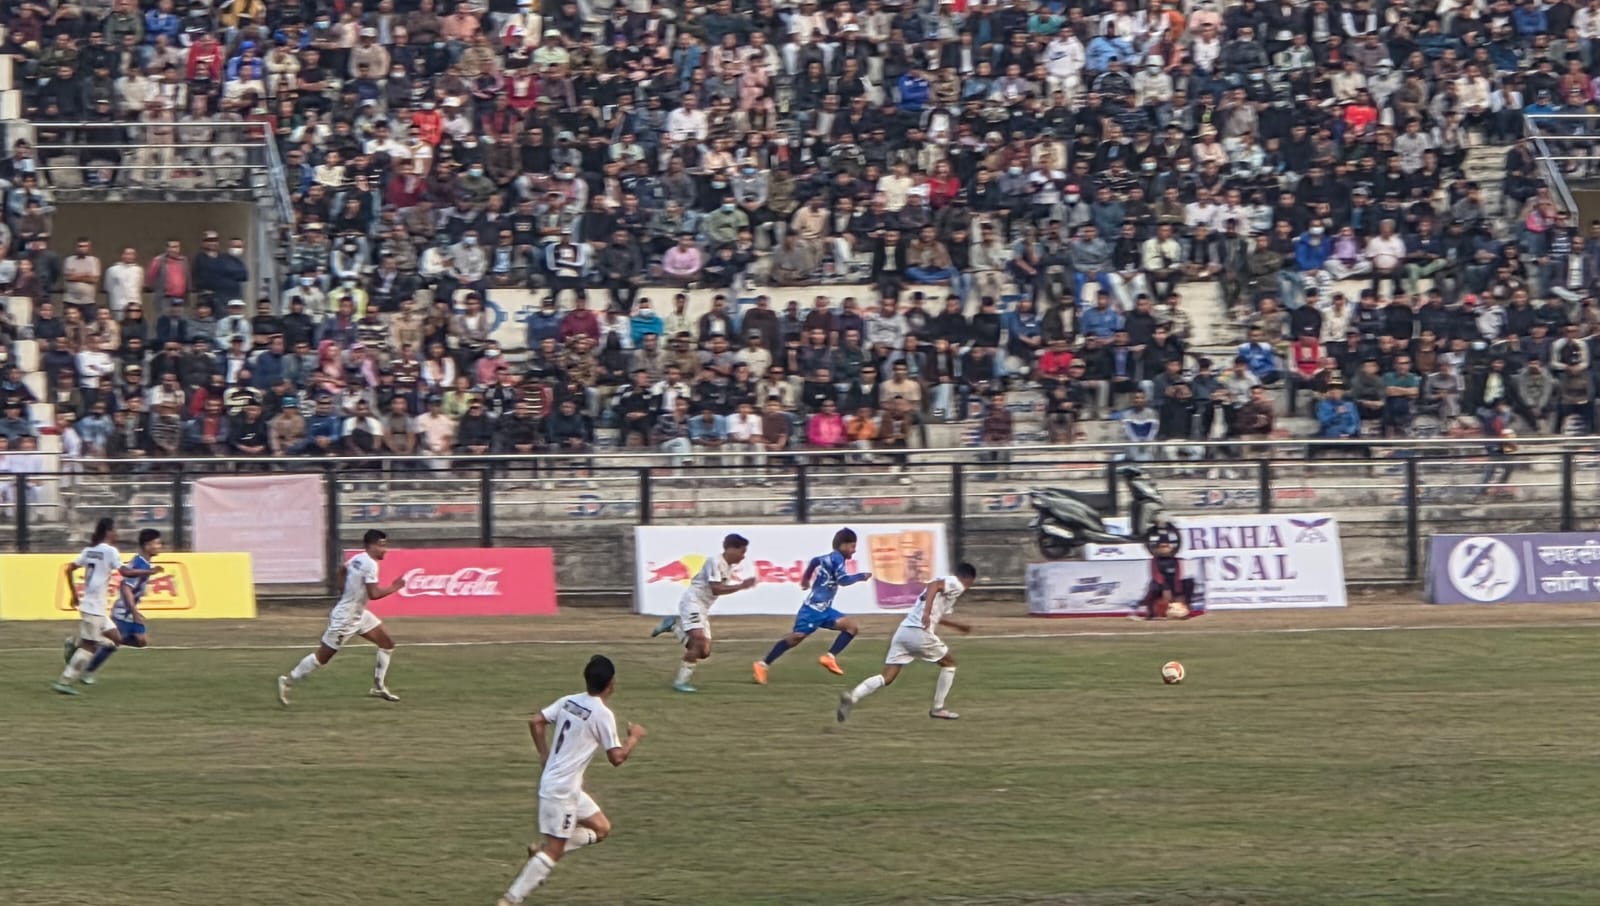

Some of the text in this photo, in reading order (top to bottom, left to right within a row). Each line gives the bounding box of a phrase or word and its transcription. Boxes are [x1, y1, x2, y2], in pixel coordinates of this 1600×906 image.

[1188, 525, 1286, 550] RKHA
[753, 560, 801, 583] Red
[1189, 554, 1298, 581] TSAL
